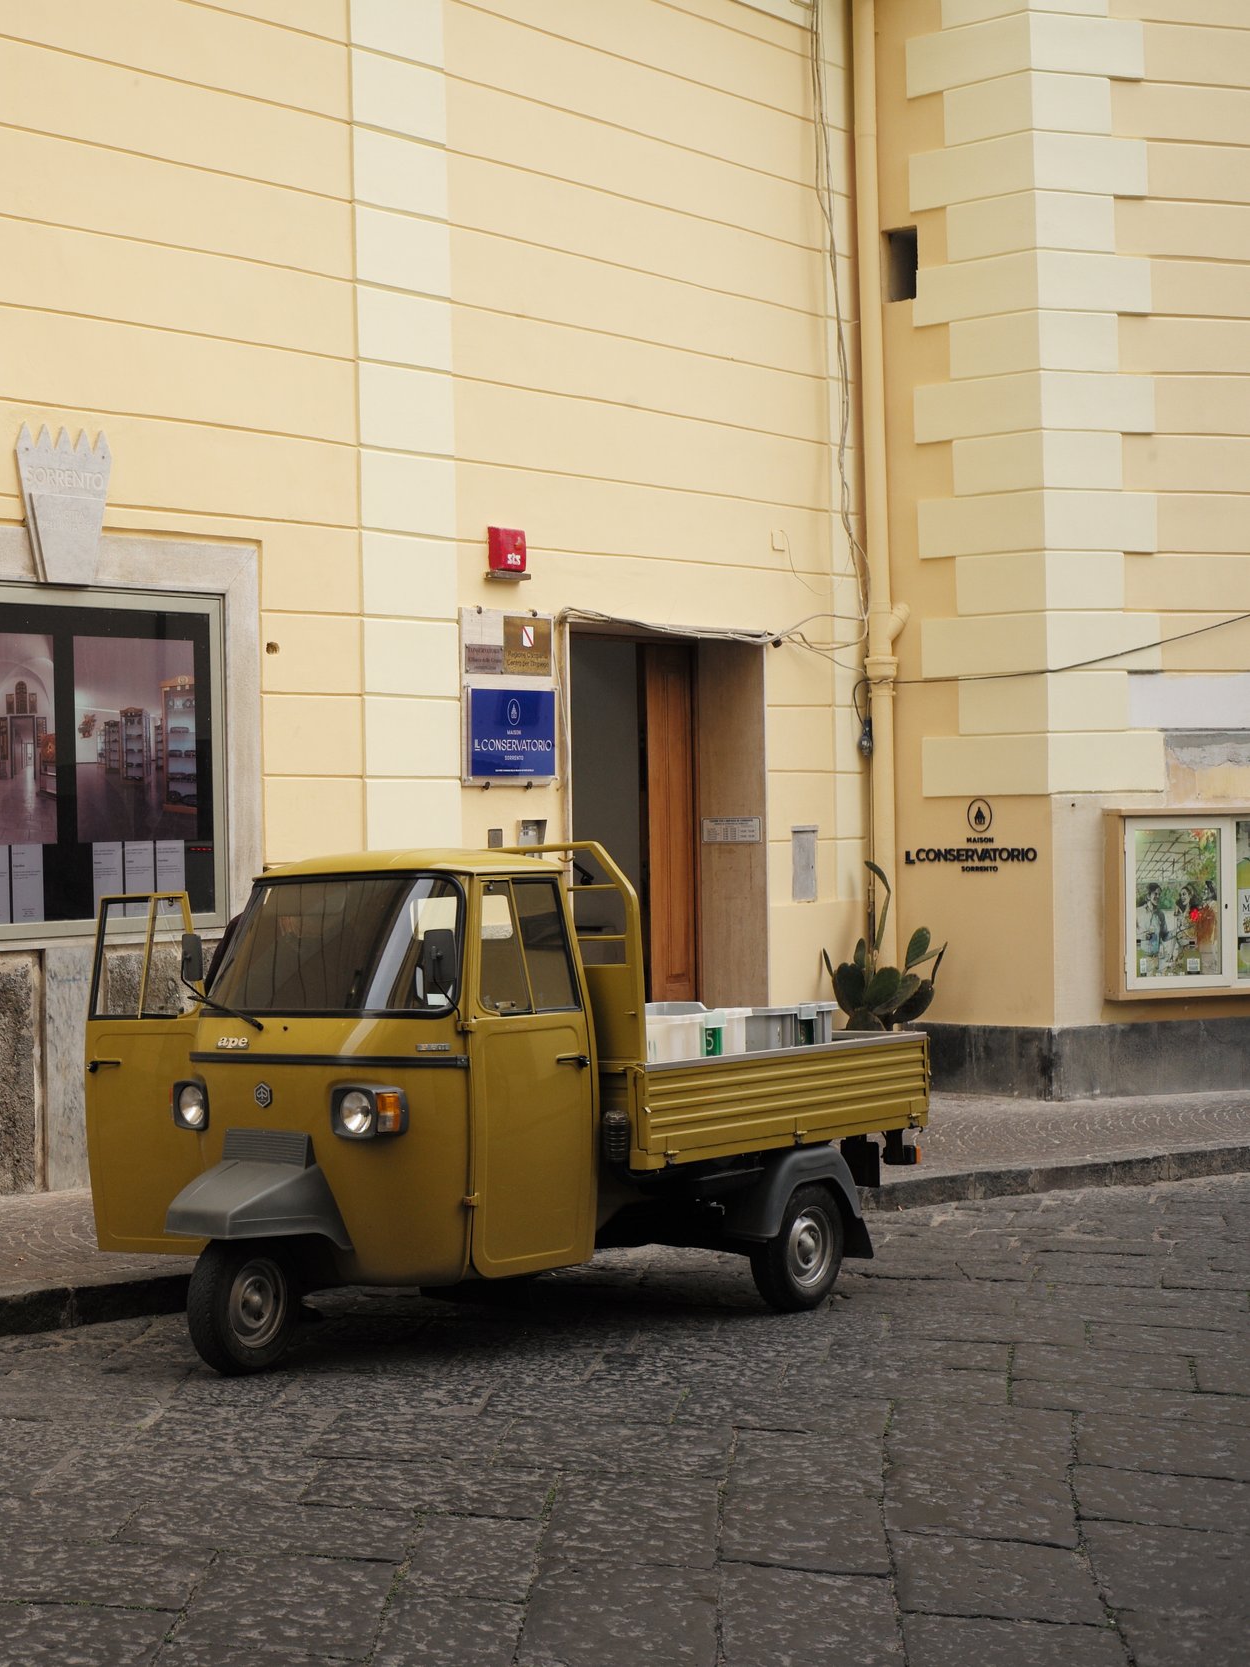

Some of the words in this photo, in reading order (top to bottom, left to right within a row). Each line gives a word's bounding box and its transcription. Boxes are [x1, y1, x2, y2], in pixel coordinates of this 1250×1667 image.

[27, 464, 104, 490] SORRENTO
[481, 739, 552, 752] CONSERVATORIO
[916, 847, 1038, 862] CONSERVATORIO
[217, 1036, 248, 1049] ape
[706, 1030, 714, 1050] 5
